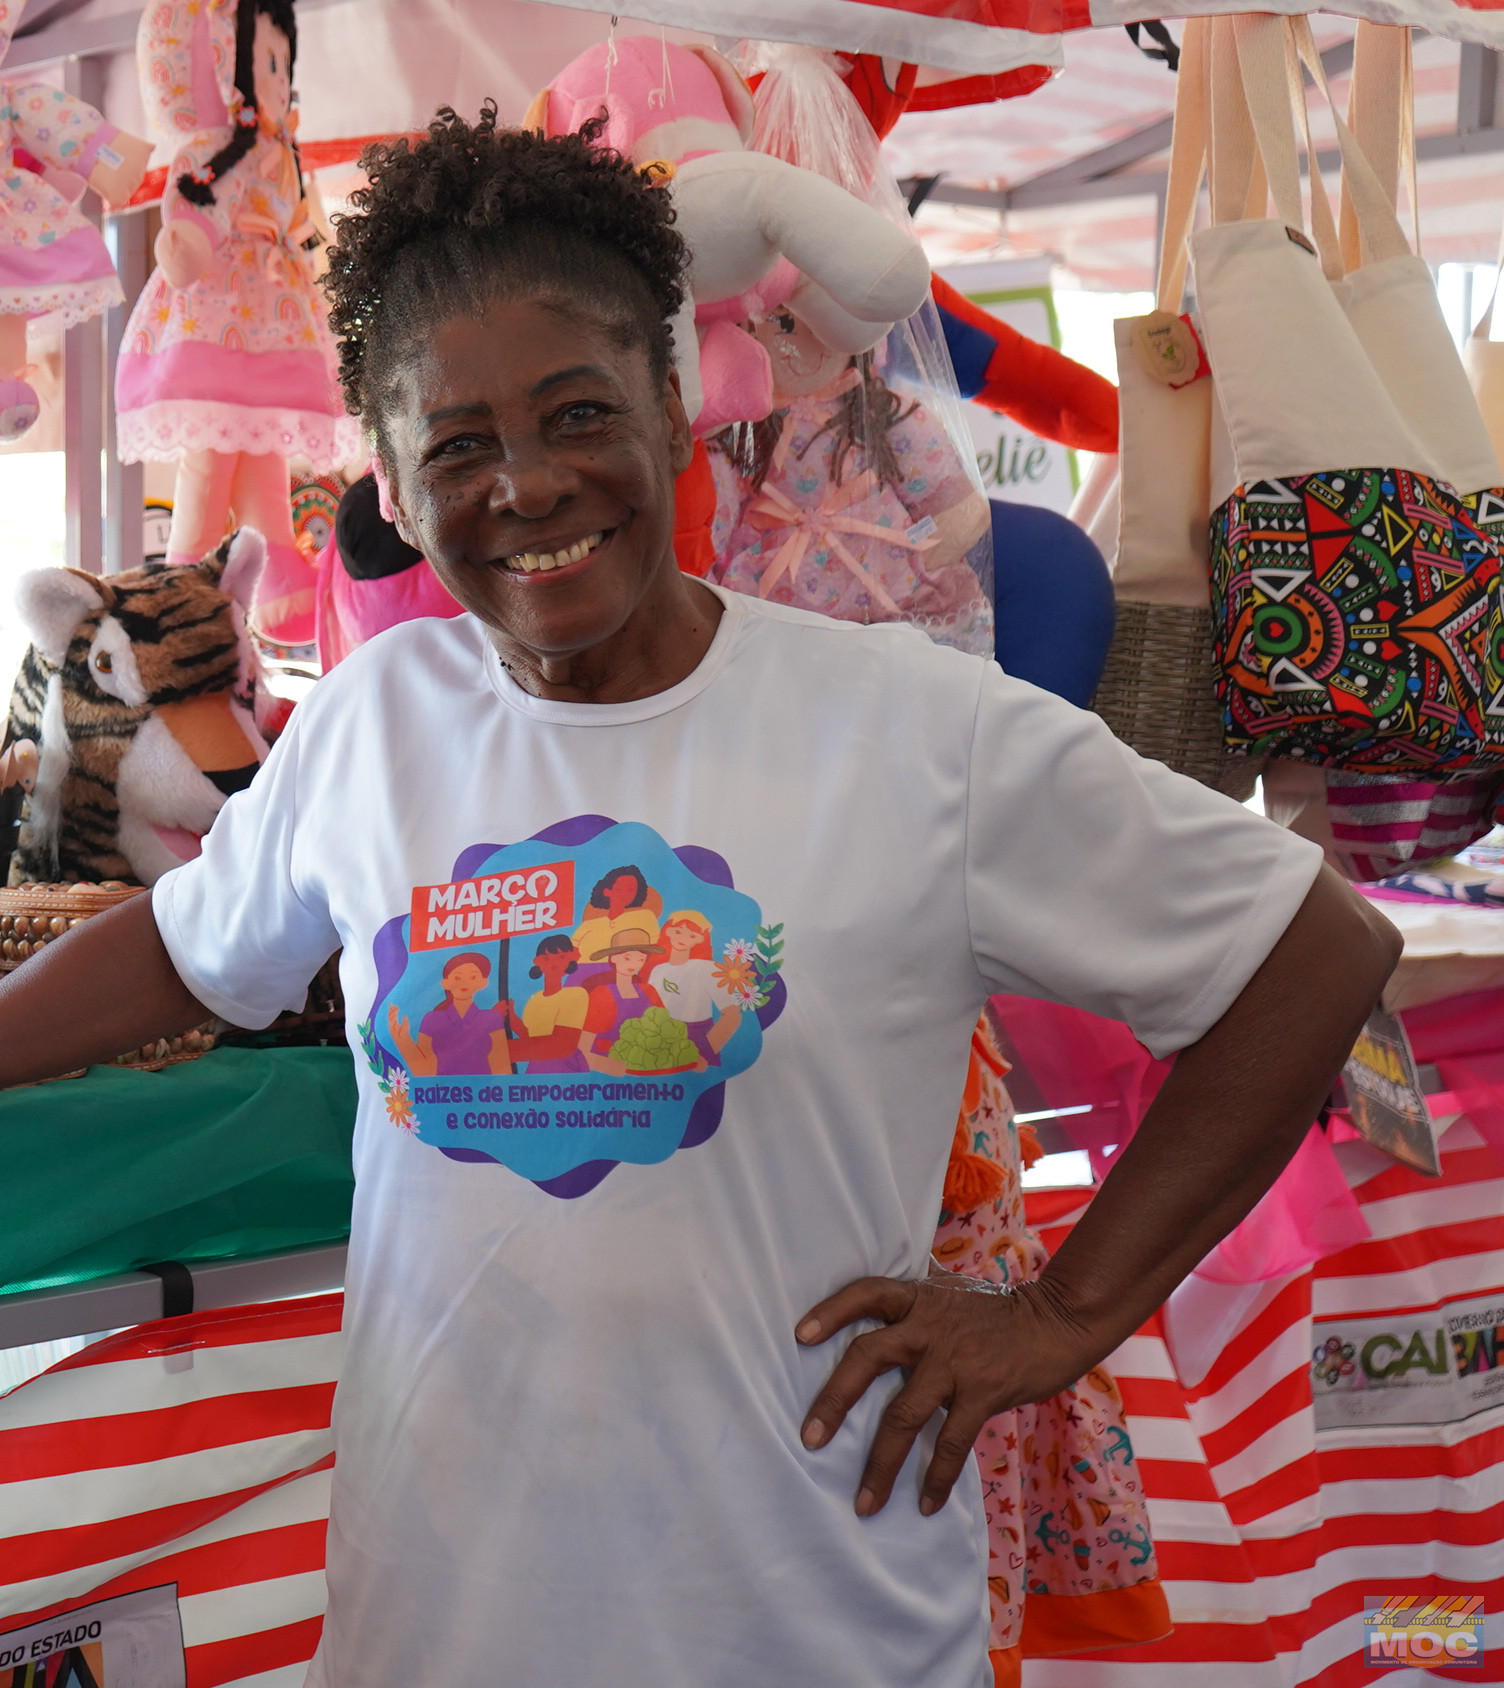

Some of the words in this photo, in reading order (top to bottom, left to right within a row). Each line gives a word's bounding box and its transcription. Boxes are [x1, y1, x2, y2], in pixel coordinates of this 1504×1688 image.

[427, 869, 558, 912] MARÇO
[426, 901, 558, 942] MULHER
[478, 1086, 504, 1103] de
[508, 1083, 684, 1103] Empoderamento
[446, 1111, 458, 1129] e
[463, 1108, 550, 1129] conexão
[556, 1107, 651, 1129] solidária
[30, 1620, 102, 1658] ESTADO
